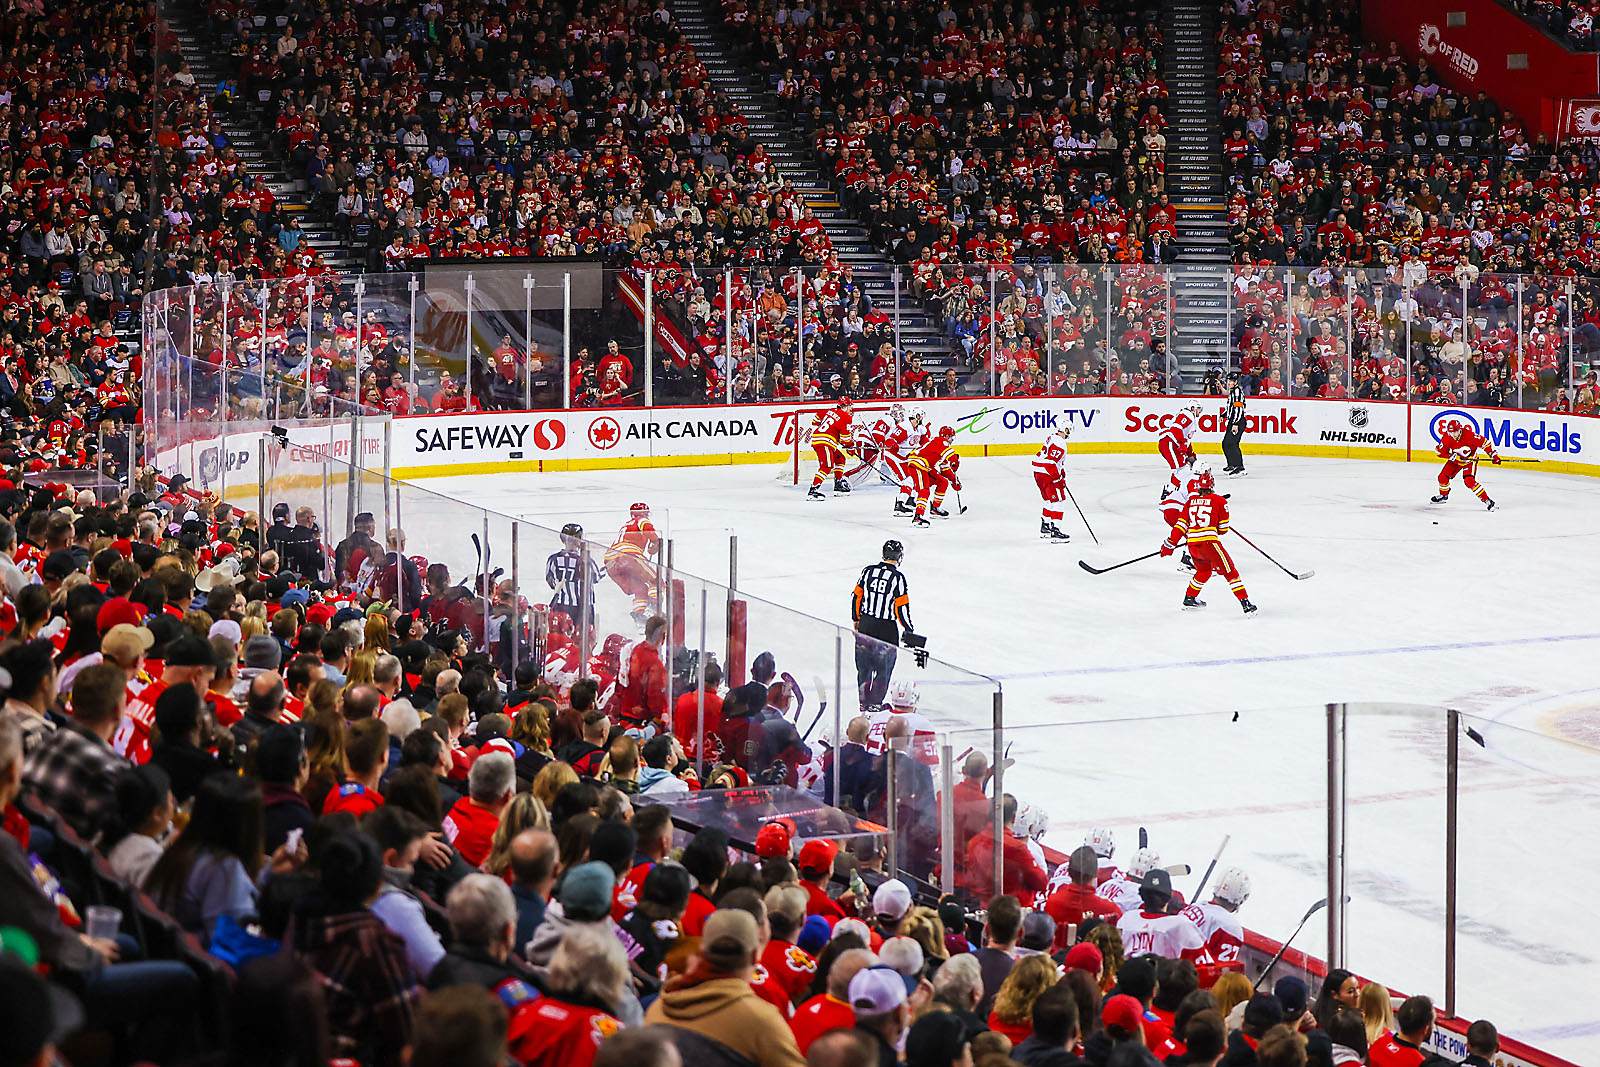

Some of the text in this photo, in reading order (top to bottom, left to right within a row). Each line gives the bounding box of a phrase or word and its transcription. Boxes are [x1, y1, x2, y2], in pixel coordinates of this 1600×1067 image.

[1439, 41, 1453, 56] OF
[1451, 47, 1479, 75] RED
[625, 420, 758, 440] AIR CANADA
[1002, 408, 1058, 433] Optik
[415, 424, 530, 453] SAFEWAY
[1319, 430, 1397, 445] NHLSHOP.CA
[1484, 417, 1582, 454] Medals
[1050, 449, 1062, 459] 37
[1188, 505, 1213, 528] 55
[558, 567, 576, 581] 77
[869, 578, 888, 594] 48
[1132, 932, 1155, 952] LYON
[1218, 943, 1240, 962] 27
[1433, 1030, 1447, 1050] THE
[1449, 1036, 1469, 1059] POW
